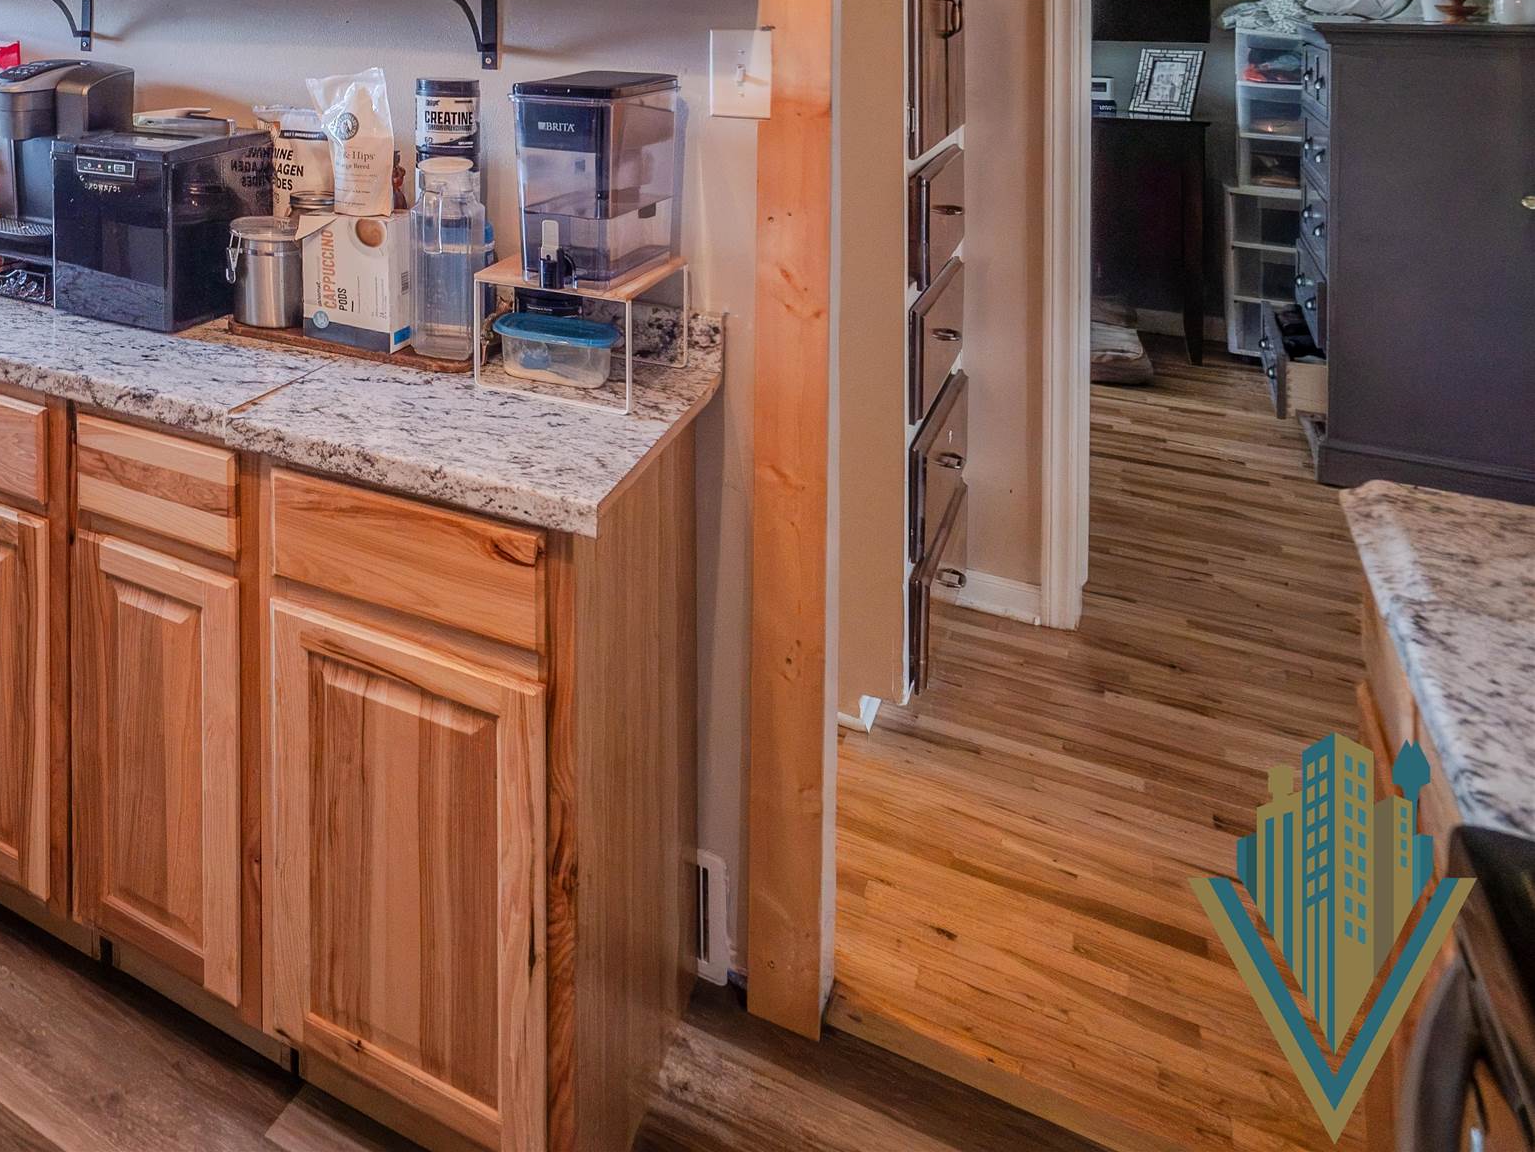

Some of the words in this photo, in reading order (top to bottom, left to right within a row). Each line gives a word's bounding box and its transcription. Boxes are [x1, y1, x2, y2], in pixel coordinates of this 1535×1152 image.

[424, 110, 474, 125] CREATINE
[546, 121, 575, 133] BRITA
[352, 151, 374, 163] Hips
[275, 163, 304, 177] AGEN
[274, 176, 294, 191] DES
[321, 229, 338, 309] CAPPUCCINO
[337, 287, 348, 312] PODS
